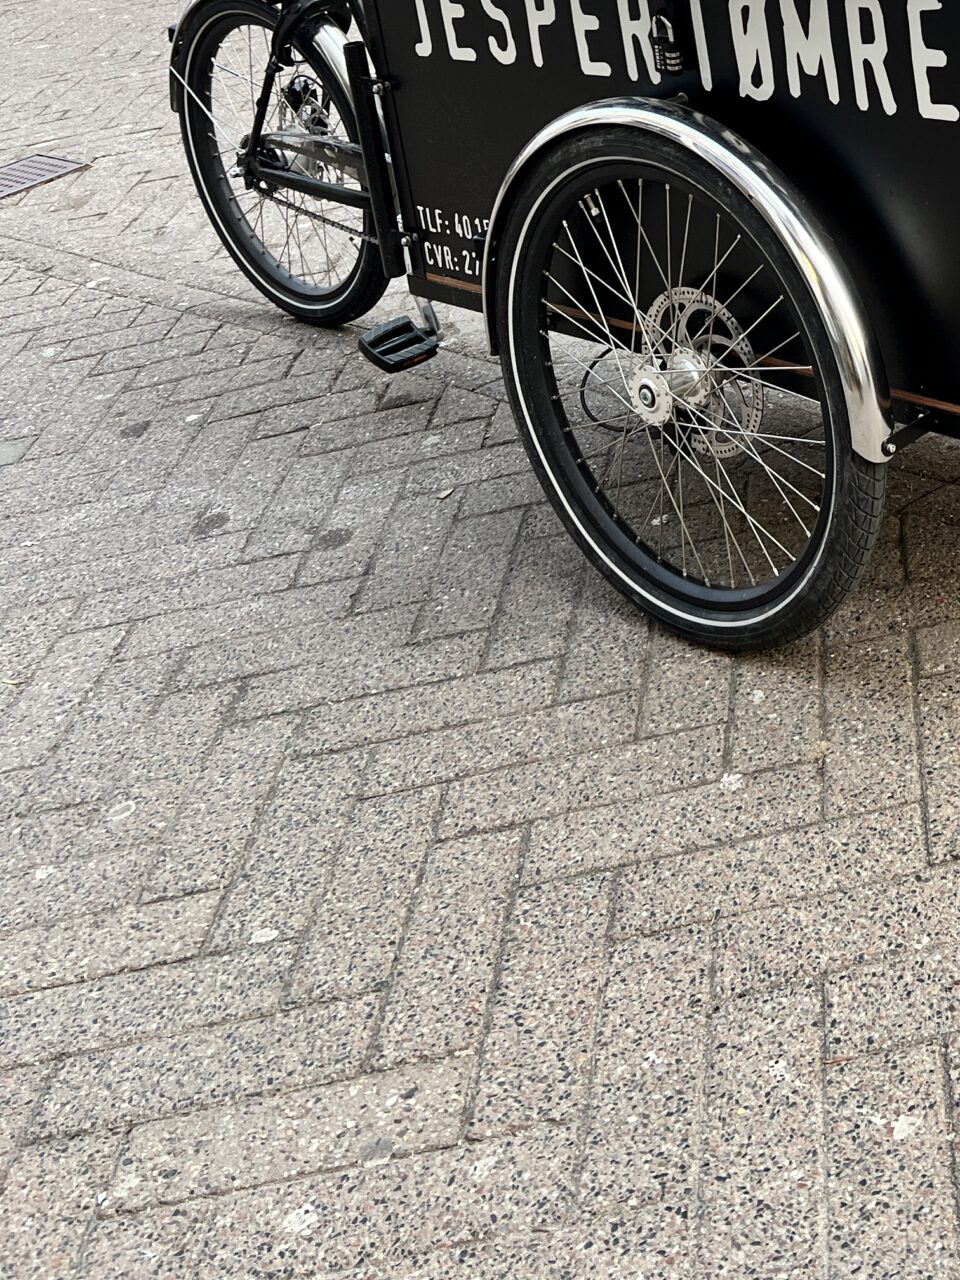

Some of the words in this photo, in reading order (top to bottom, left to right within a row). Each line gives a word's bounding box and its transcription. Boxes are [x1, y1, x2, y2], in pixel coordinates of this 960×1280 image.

[416, 205, 451, 235] TLF:
[454, 212, 473, 240] 40
[424, 241, 460, 272] CVR:
